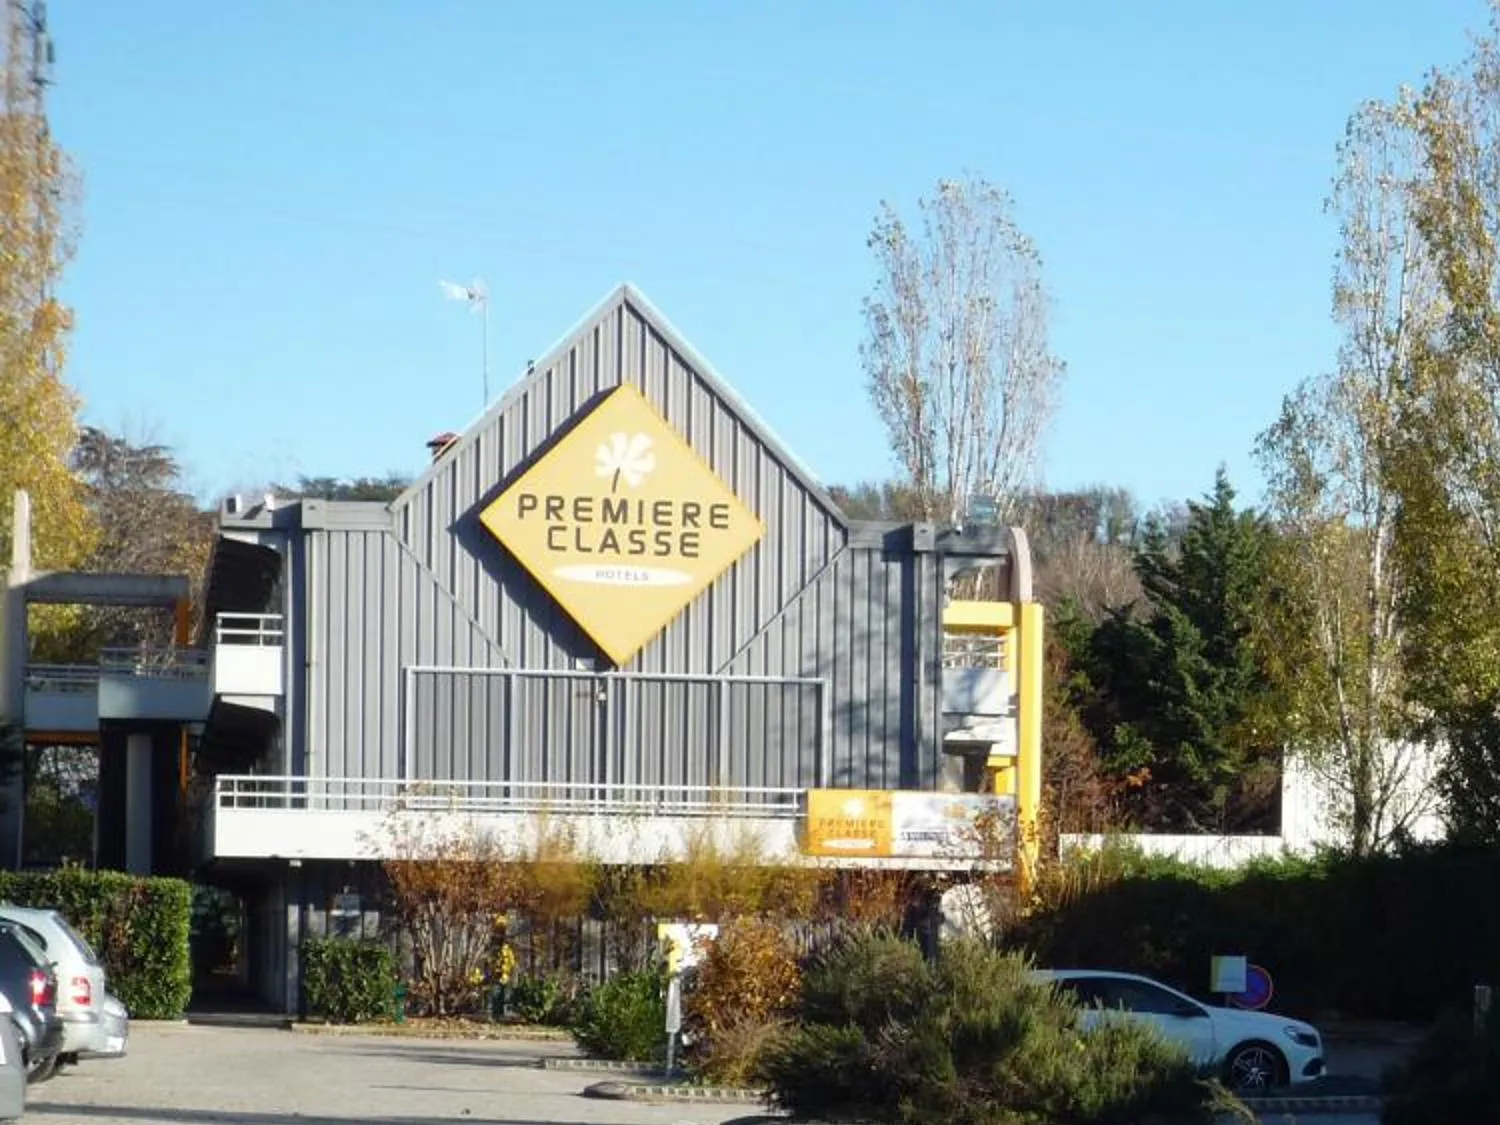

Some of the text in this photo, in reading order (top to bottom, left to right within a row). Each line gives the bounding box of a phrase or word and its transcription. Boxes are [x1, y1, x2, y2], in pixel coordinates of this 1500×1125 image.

[518, 493, 729, 530] PREMIERE
[547, 526, 699, 558] CLASSE
[596, 569, 649, 581] HOTELS
